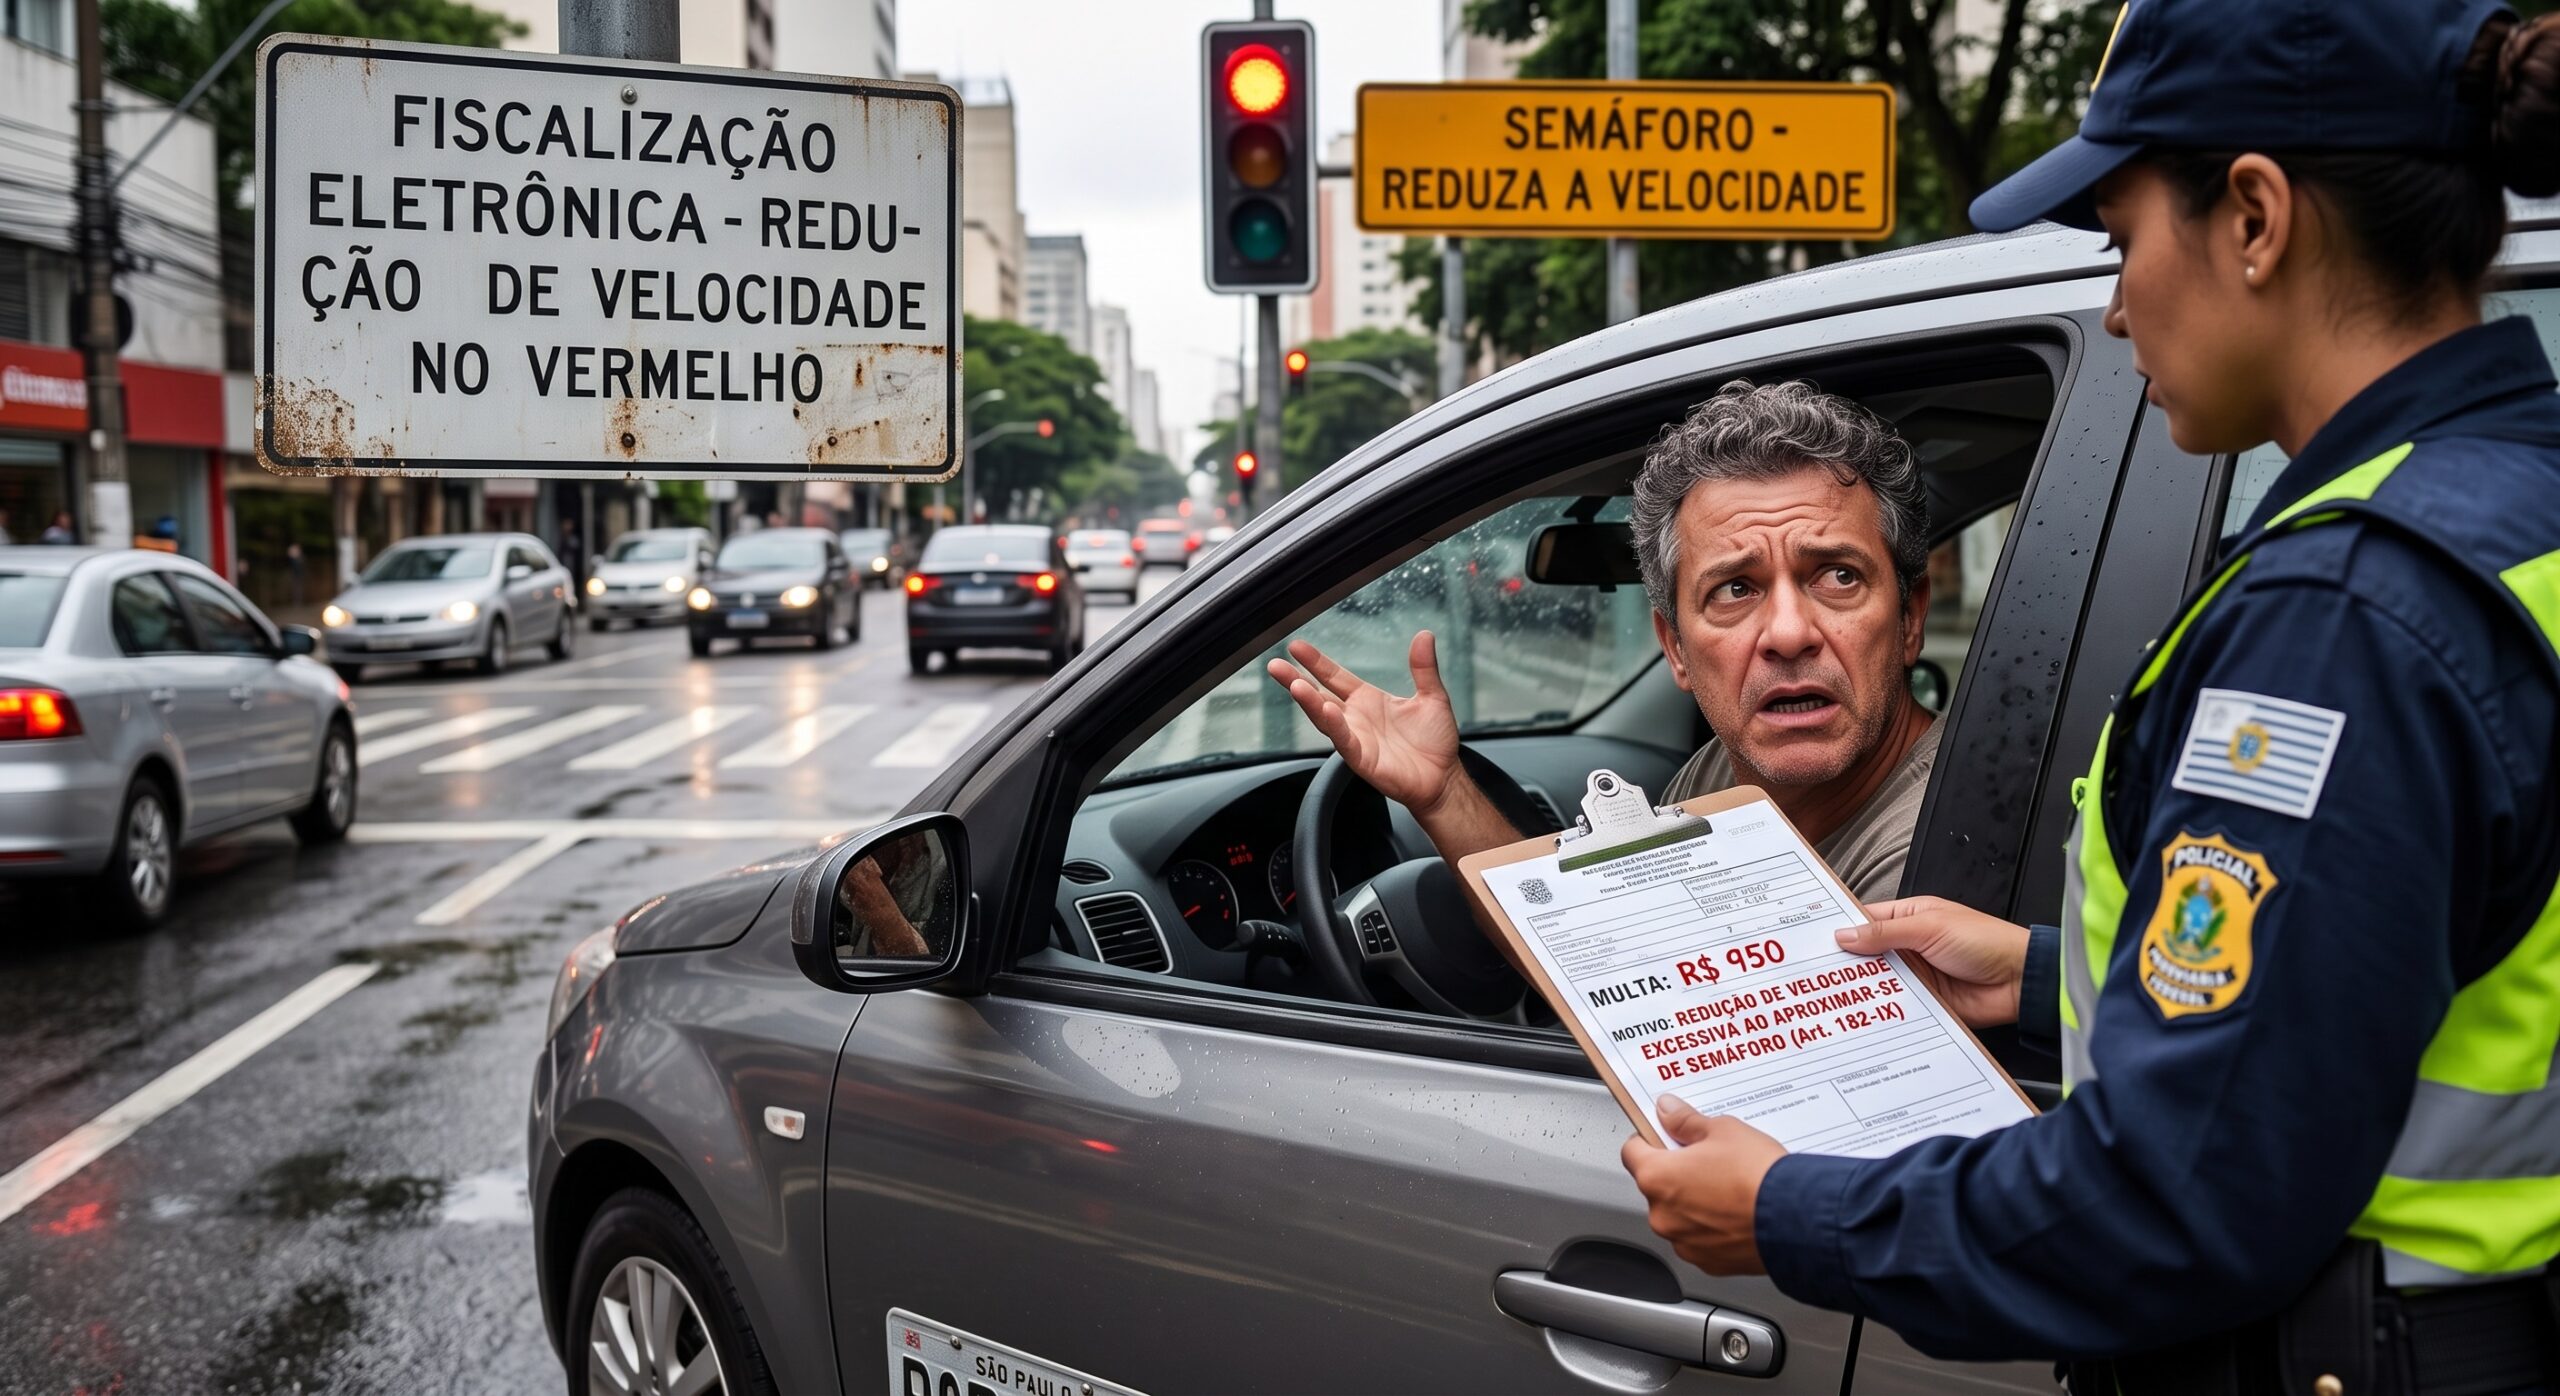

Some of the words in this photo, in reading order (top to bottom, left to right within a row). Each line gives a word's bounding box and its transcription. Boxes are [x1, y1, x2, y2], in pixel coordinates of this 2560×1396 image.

[394, 94, 836, 181] FISCALIZAÇÃO
[1503, 96, 1754, 152] SEMÁFORO
[1771, 125, 1789, 136] -
[309, 171, 708, 245] ELETRÔNICA
[724, 217, 742, 227] -
[761, 197, 922, 253] REDU-
[1382, 166, 1549, 212] REDUZA
[1565, 168, 1593, 212] A
[1608, 169, 1866, 214] VELOCIDADE
[302, 244, 421, 322] ÇÃO
[488, 263, 560, 317] DE
[591, 267, 926, 331] VELOCIDADE
[412, 340, 489, 396] NO
[525, 344, 823, 404] VERMELHO
[2173, 845, 2255, 891] POLICIAL
[1588, 975, 1673, 1008] MULTA:
[1676, 953, 1721, 986] R$
[1725, 939, 1785, 973] 950
[1612, 1017, 1675, 1042] MOTIVO:
[1675, 993, 1758, 1027] REDUÇÃO
[1759, 985, 1786, 1005] DE
[1785, 956, 1892, 997] VELOCIDADE
[1640, 1022, 1742, 1060] EXCESSIVA
[1744, 1014, 1769, 1034] AO
[1773, 977, 1904, 1026] APROXIMAR-SE
[1656, 1060, 1685, 1081] DE
[1686, 1033, 1787, 1073] SEMÁFORO
[1790, 1023, 1833, 1050] (Art.
[1834, 1001, 1905, 1033] 182-IX)
[975, 1355, 1008, 1385] SÃO
